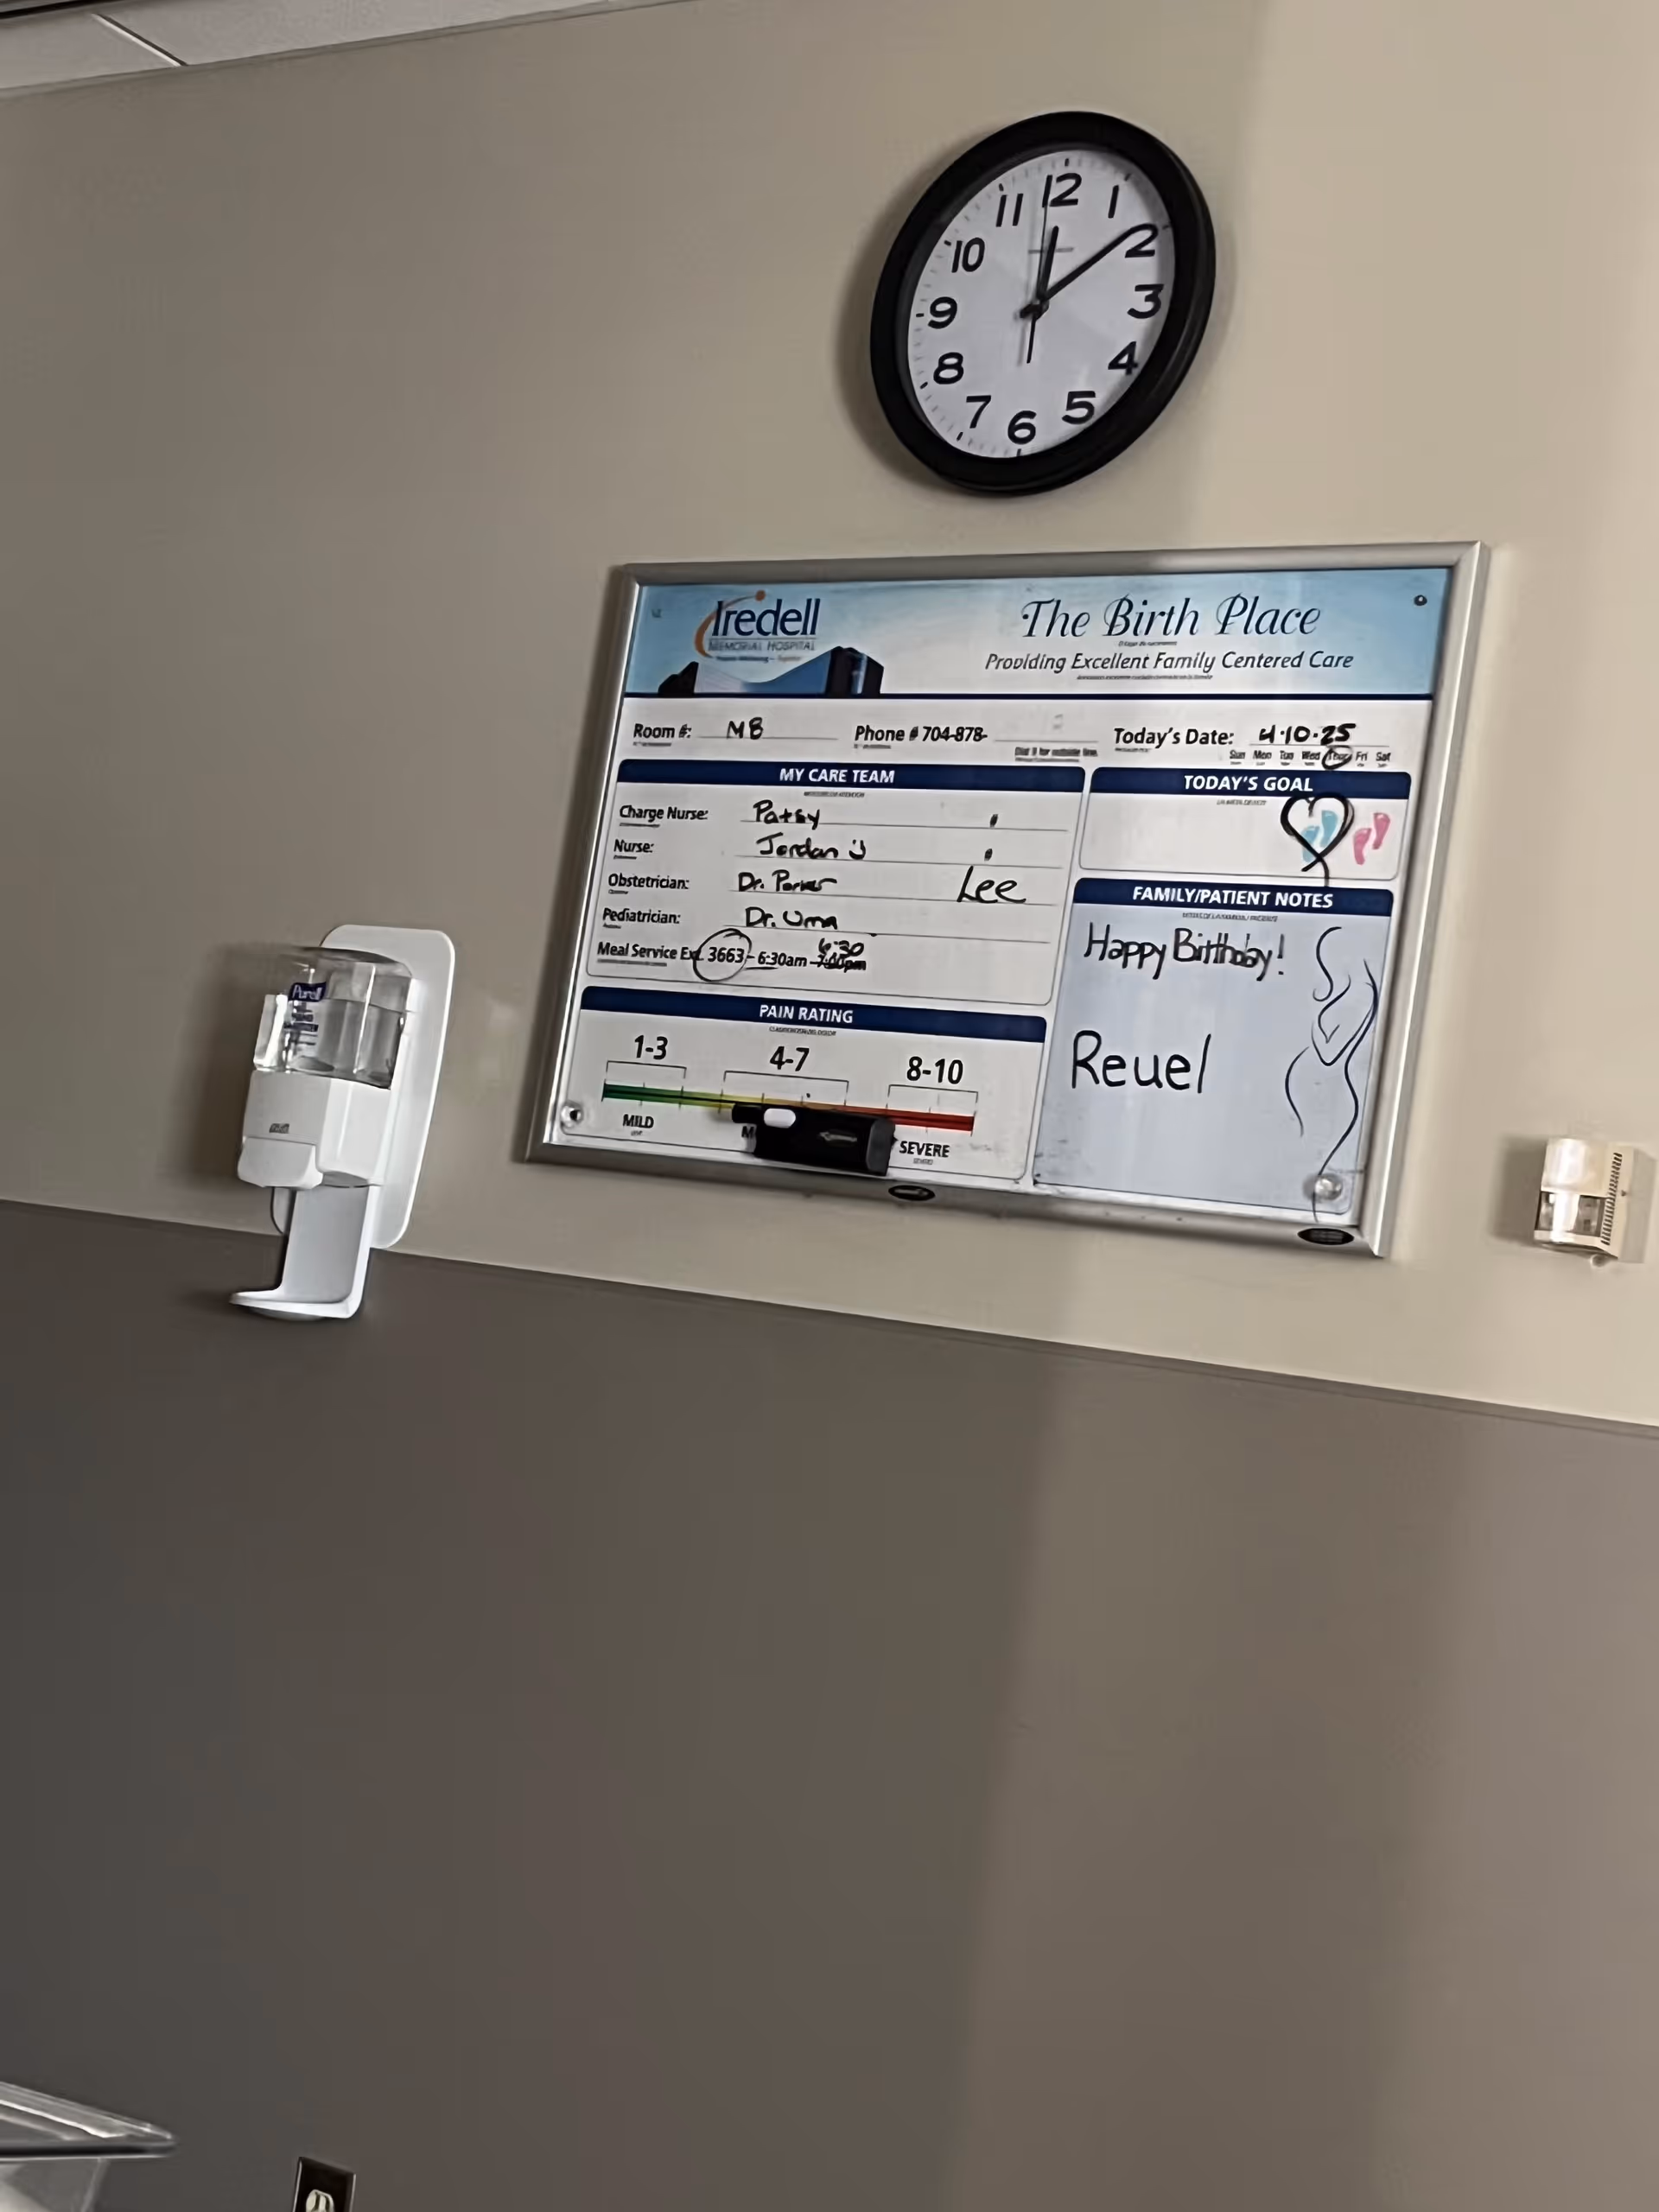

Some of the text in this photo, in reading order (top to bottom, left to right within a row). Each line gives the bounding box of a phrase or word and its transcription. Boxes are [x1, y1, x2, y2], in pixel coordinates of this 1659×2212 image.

[1042, 173, 1082, 207] 12
[1108, 184, 1120, 219] 1
[995, 193, 1024, 227] 11
[1125, 223, 1159, 258] 2
[951, 238, 985, 273] 10
[927, 297, 957, 328] 9
[1127, 284, 1164, 319] 3
[933, 352, 964, 385] 8
[1108, 341, 1138, 375] 4
[966, 395, 992, 429] 7
[1062, 391, 1096, 424] 5
[1008, 410, 1036, 444] 6
[711, 598, 821, 637] Iredell
[1020, 593, 1321, 638] The Birth Place
[767, 641, 815, 651] HOSPITAL
[985, 651, 1354, 674] Providing Excellent Family Centered Care
[633, 723, 675, 739] Room
[854, 724, 906, 741] Phone
[922, 726, 988, 742] 704-878-
[1114, 727, 1234, 749] Today's Date:
[1253, 750, 1272, 760] Mon
[1356, 752, 1369, 761] Fri
[1376, 752, 1391, 762] Sat
[779, 768, 895, 784] MY CARE TEAM
[1184, 774, 1313, 792] TODAY'S GOAL
[620, 804, 709, 822] Charge Nurse:
[613, 839, 654, 854] Nurse:
[756, 832, 839, 860] Jordan
[607, 873, 690, 890] Obstetrician:
[738, 872, 765, 892] Dr.
[957, 865, 1027, 904] Lee
[1132, 886, 1334, 909] FAMILY/PATIENT NOTES
[602, 907, 681, 925] Pediatrician:
[745, 906, 776, 927] Dr.
[597, 941, 630, 957] Meal
[632, 944, 677, 960] Service
[708, 946, 745, 963] 3663
[758, 951, 808, 967] 6:30am
[1084, 922, 1285, 982] Happy Birthday!
[759, 1005, 854, 1024] PAIN RATING
[633, 1035, 669, 1061] 1-3
[769, 1046, 810, 1072] 4-7
[906, 1056, 964, 1085] 8-10
[1071, 1030, 1211, 1094] Reuel
[622, 1114, 655, 1129] MILD
[899, 1140, 950, 1159] SEVERE
